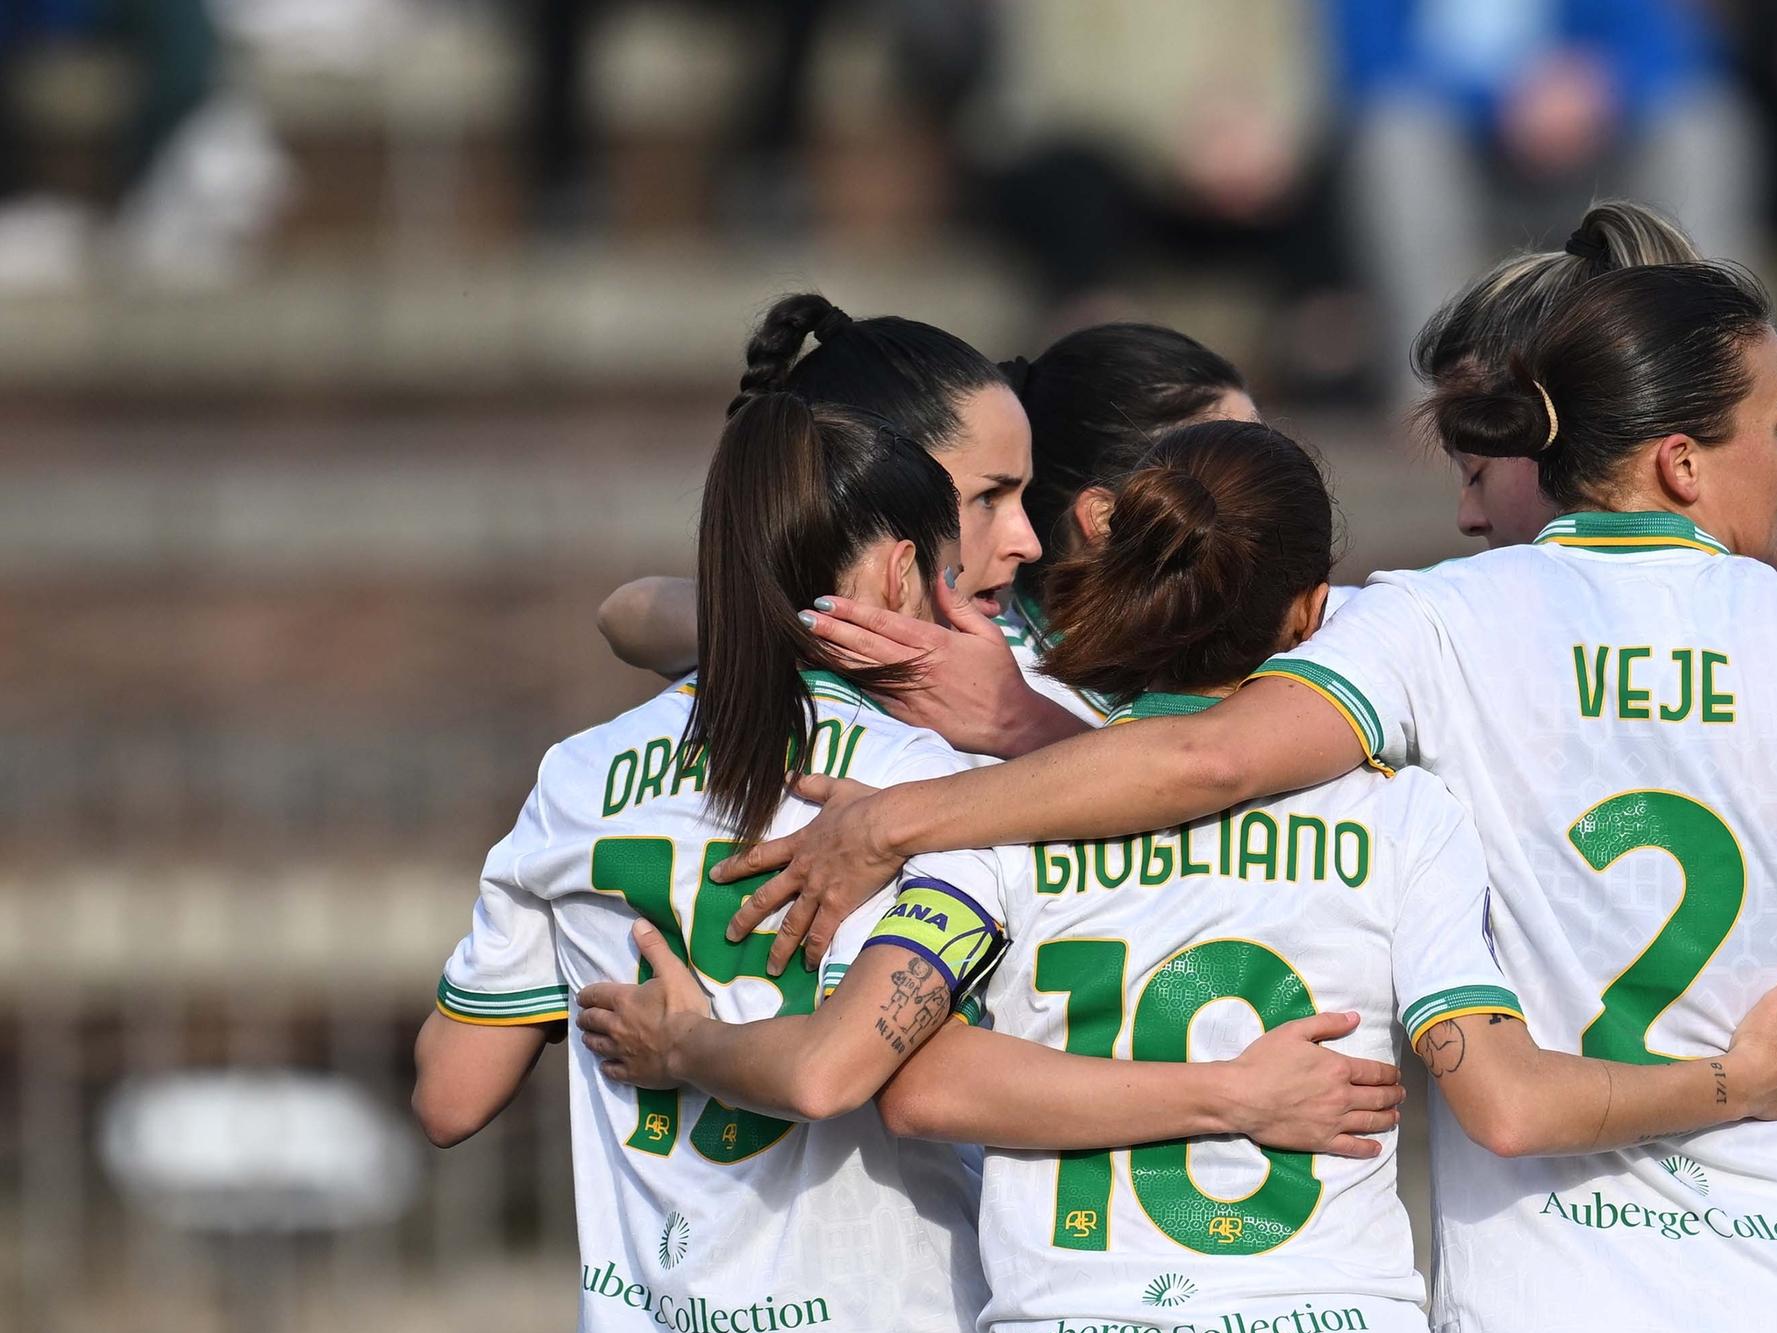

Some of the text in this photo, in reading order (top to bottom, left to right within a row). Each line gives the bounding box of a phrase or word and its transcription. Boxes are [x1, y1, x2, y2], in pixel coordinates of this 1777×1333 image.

[1573, 643, 1737, 724] VEJE
[1032, 808, 1373, 896] GIUGLIANO
[880, 903, 949, 933] ANA
[1567, 787, 1749, 1070] 2
[591, 835, 822, 1166] 15
[1033, 938, 1327, 1257] 10
[1539, 1191, 1701, 1241] Auberge
